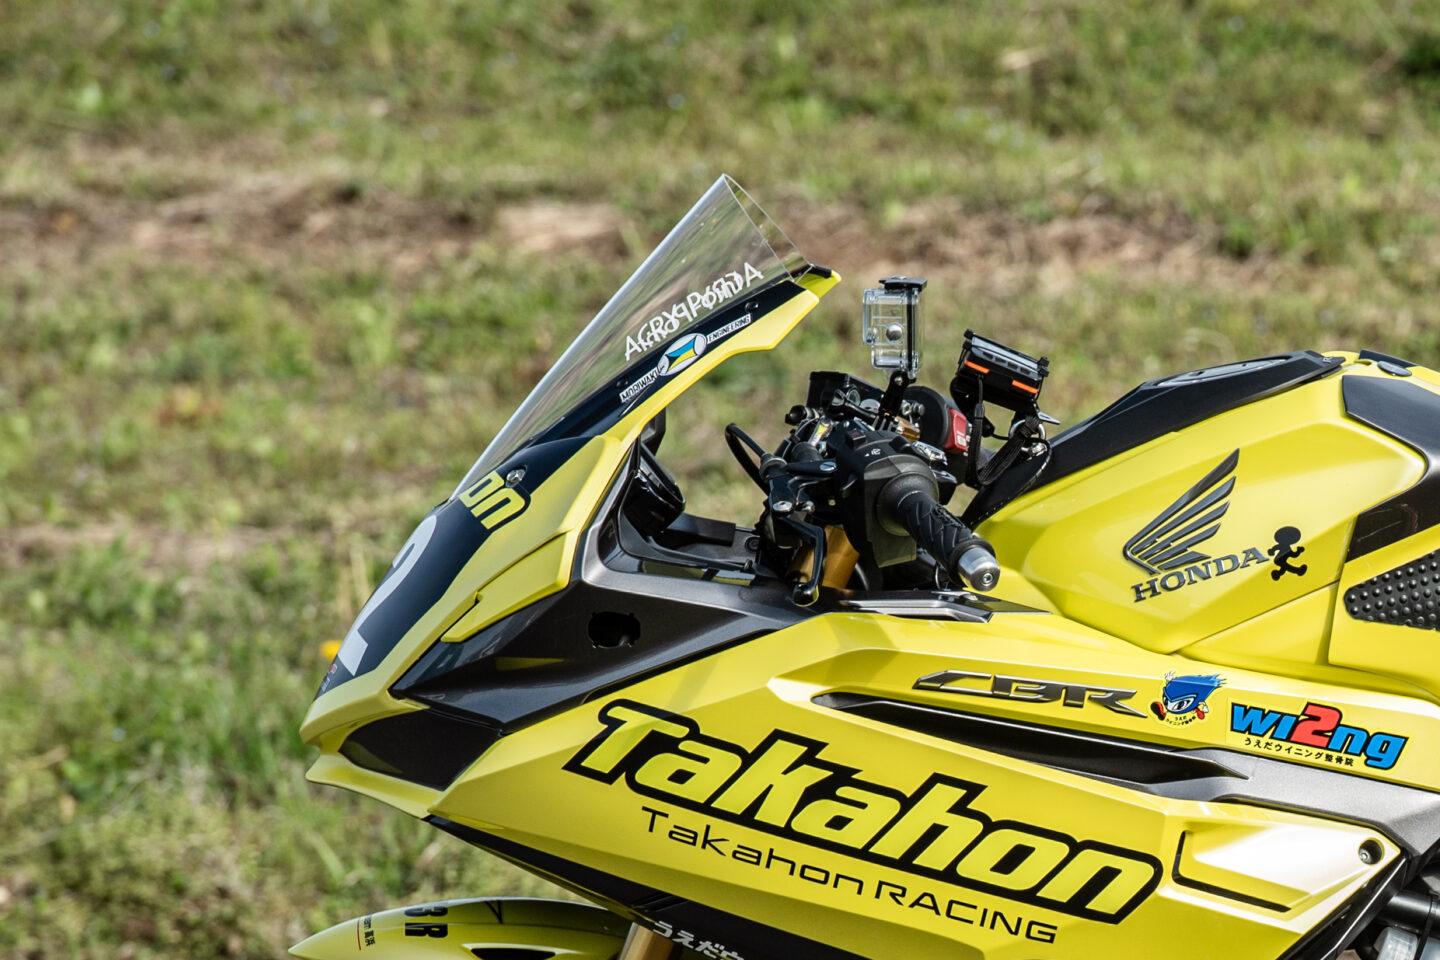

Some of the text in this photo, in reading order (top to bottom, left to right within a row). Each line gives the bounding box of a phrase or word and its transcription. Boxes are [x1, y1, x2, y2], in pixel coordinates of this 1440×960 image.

[1131, 547, 1270, 602] HONDA
[912, 670, 1148, 718] CBR
[562, 698, 1163, 924] Takahon
[641, 806, 1058, 945] Takahon RACING
